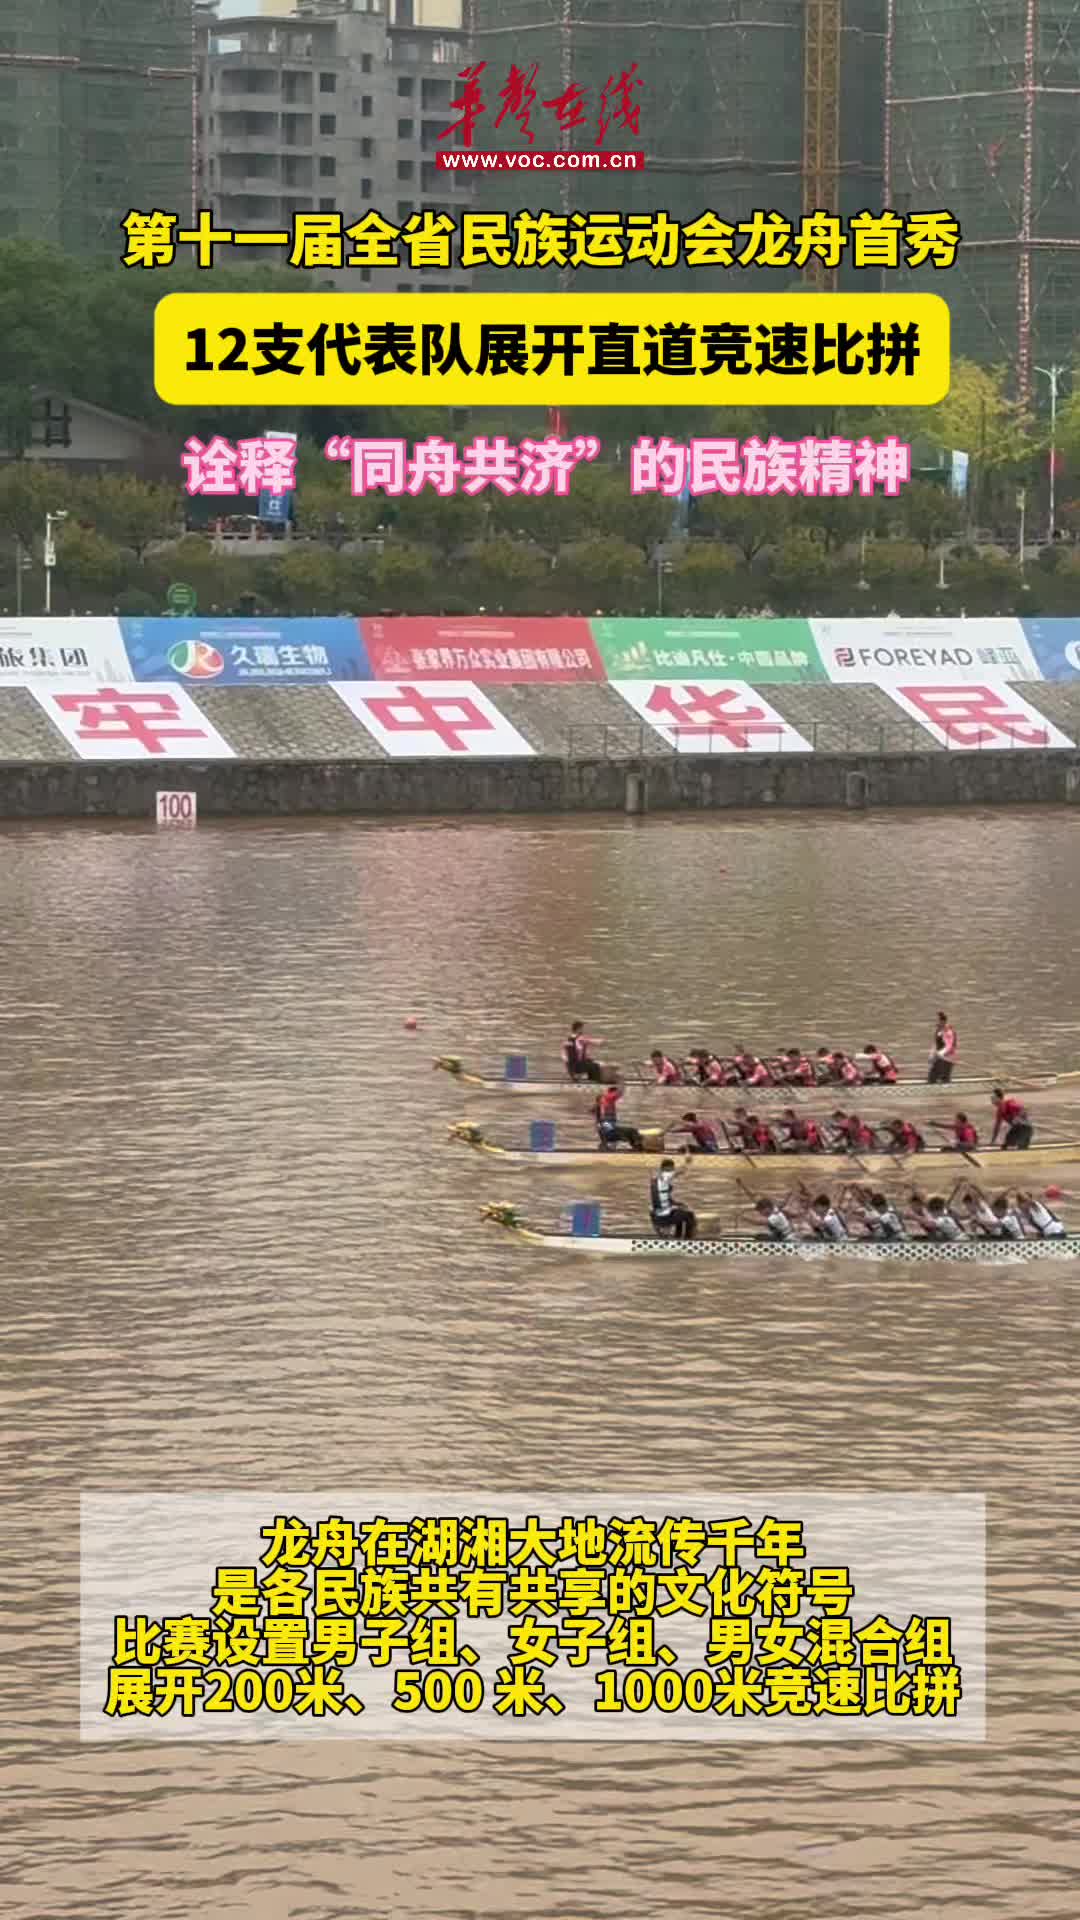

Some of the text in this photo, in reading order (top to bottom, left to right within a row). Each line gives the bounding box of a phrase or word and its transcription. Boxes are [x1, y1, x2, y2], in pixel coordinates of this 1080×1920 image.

[858, 647, 973, 667] FOREYAD
[52, 684, 1051, 754] 牢 中 华 民
[159, 794, 192, 818] 100
